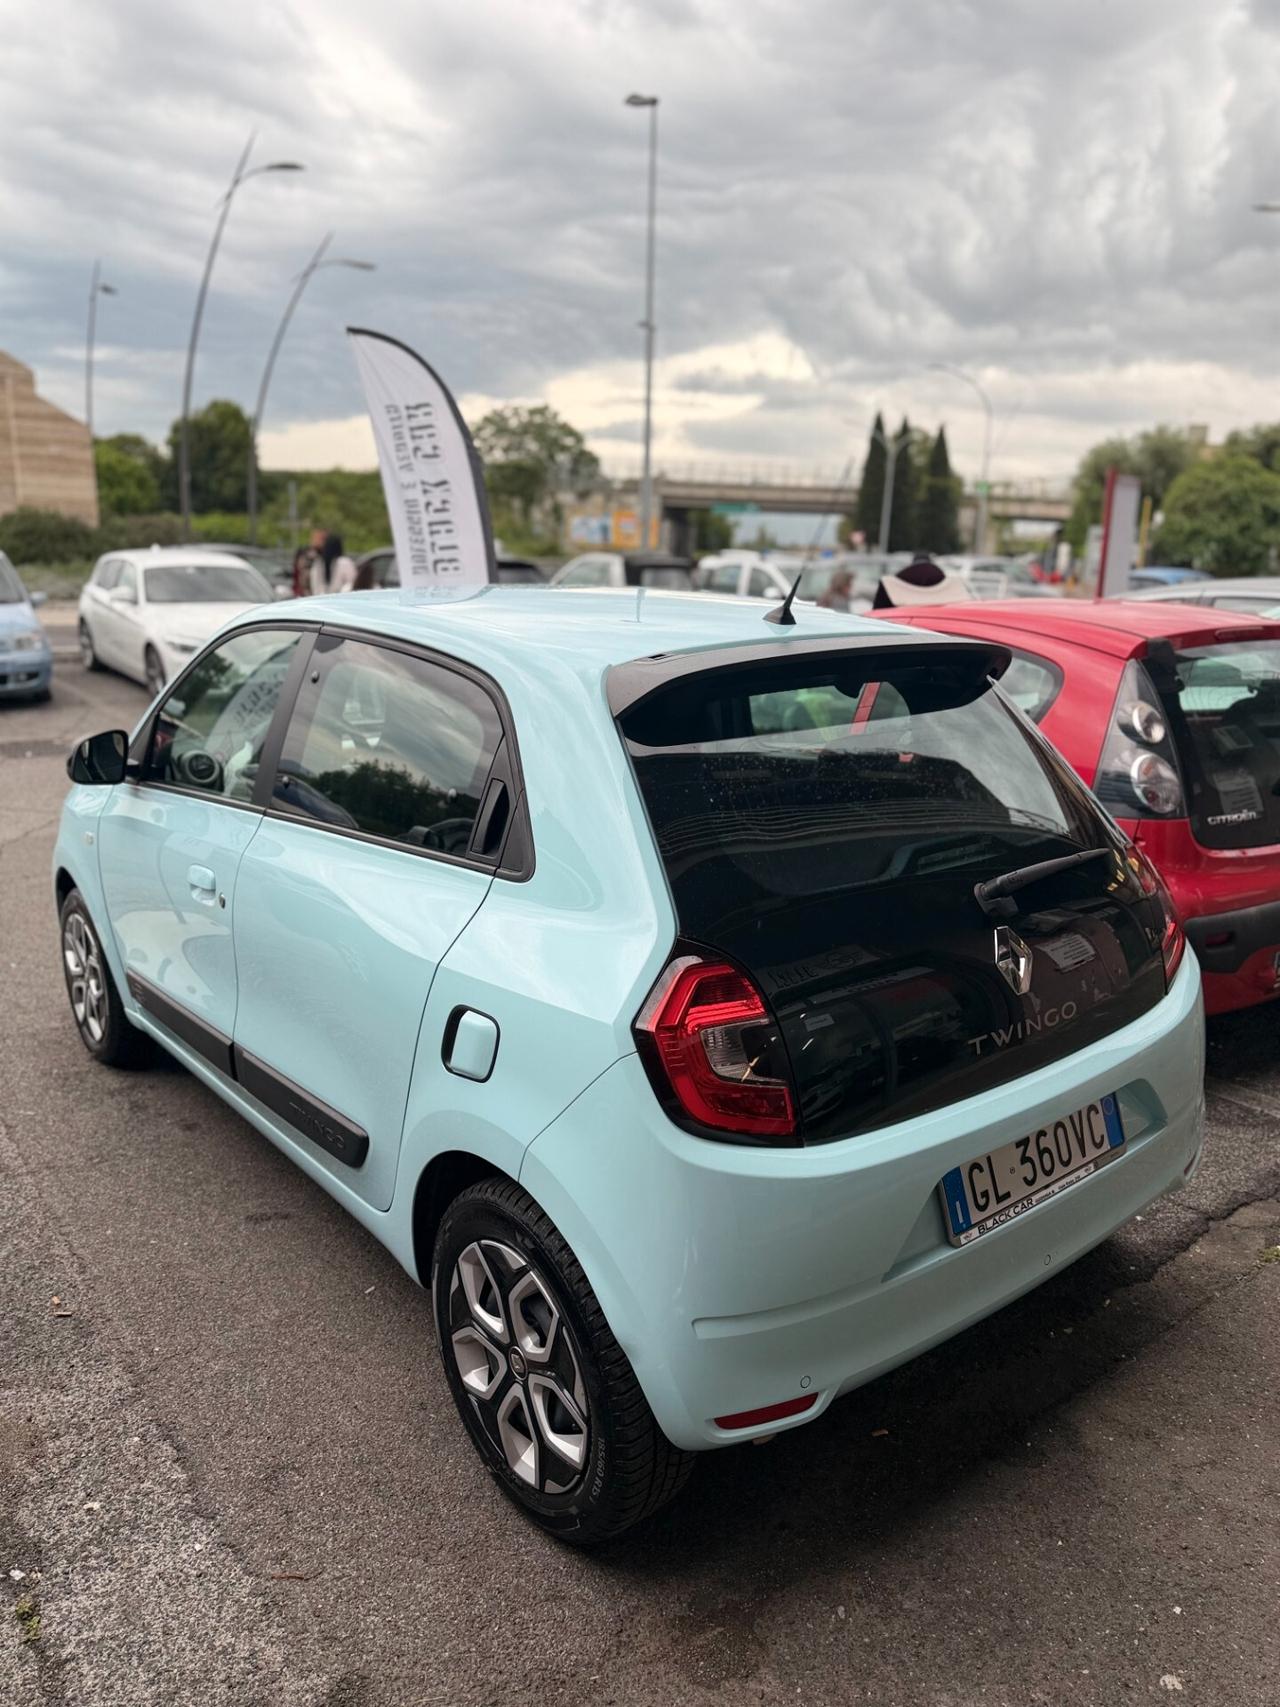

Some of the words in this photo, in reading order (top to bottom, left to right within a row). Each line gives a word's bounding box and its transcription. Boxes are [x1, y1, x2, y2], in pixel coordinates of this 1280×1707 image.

[967, 1001, 1077, 1056] TWINGO
[968, 1155, 1011, 1212] GL
[1015, 1103, 1105, 1187] 360VC
[977, 1209, 1013, 1235] BLACK
[1013, 1198, 1034, 1216] CAR
